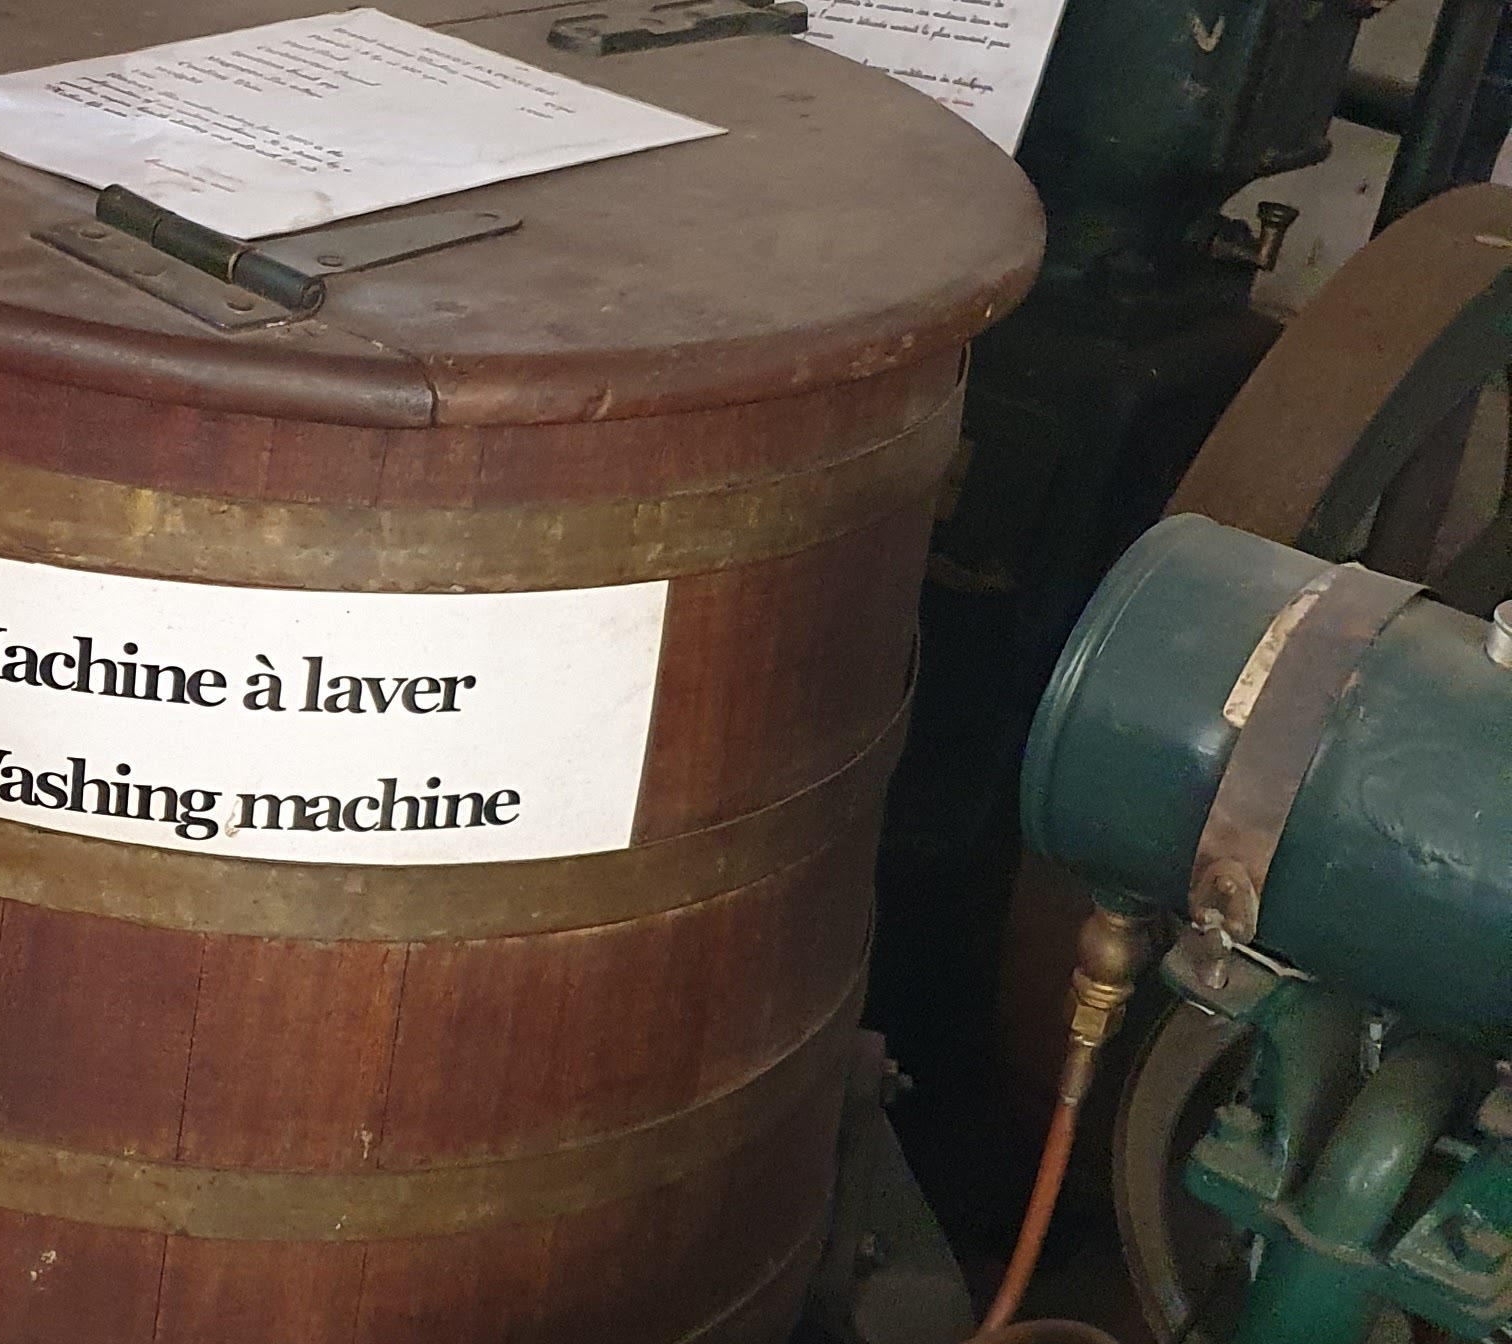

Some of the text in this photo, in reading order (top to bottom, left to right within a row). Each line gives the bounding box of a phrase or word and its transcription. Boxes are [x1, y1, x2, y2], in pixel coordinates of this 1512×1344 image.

[241, 653, 286, 714] à
[298, 655, 478, 716] laver
[234, 777, 522, 833] machine
